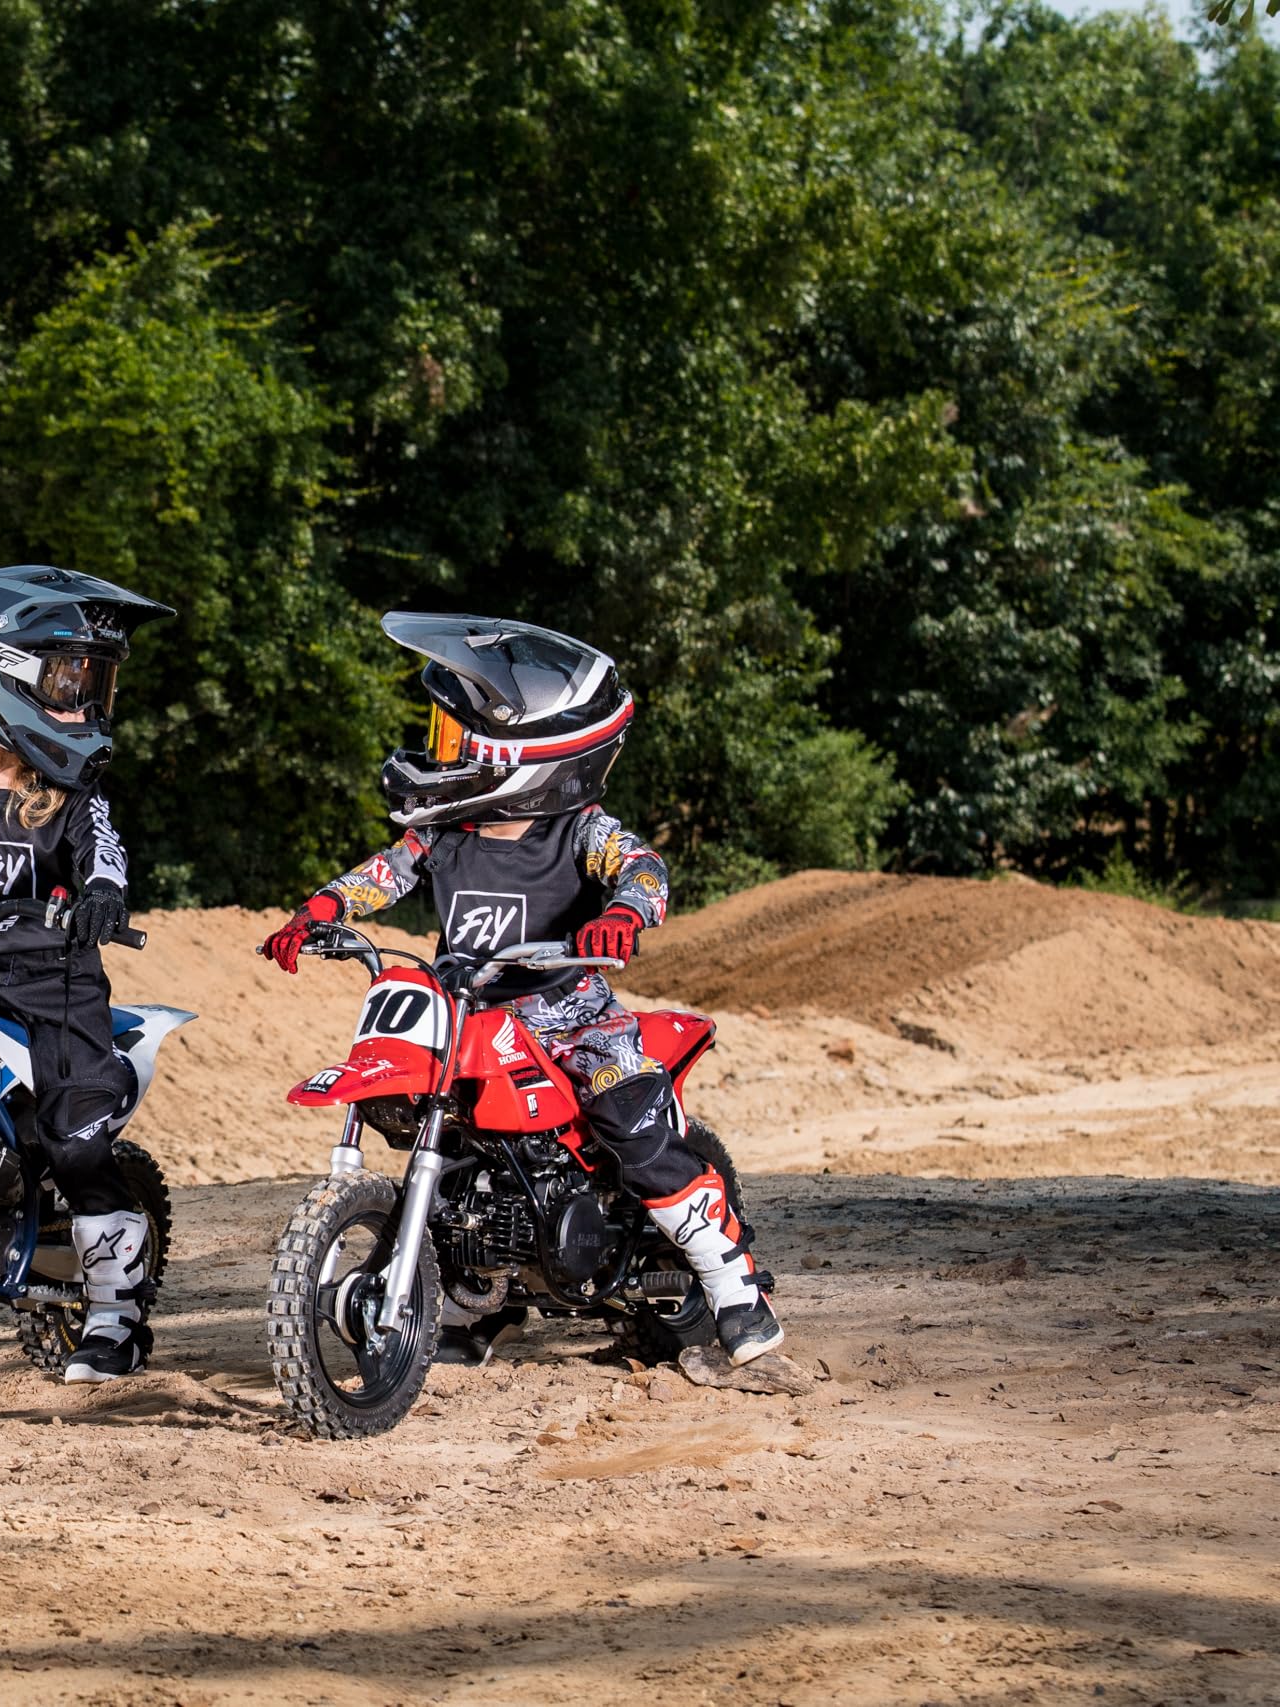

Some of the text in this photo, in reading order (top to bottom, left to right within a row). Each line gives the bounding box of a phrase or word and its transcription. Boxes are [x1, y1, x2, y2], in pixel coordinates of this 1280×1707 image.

[477, 742, 524, 766] FLY
[452, 905, 518, 950] FLY
[359, 988, 431, 1036] 10
[498, 1051, 528, 1066] HONDA
